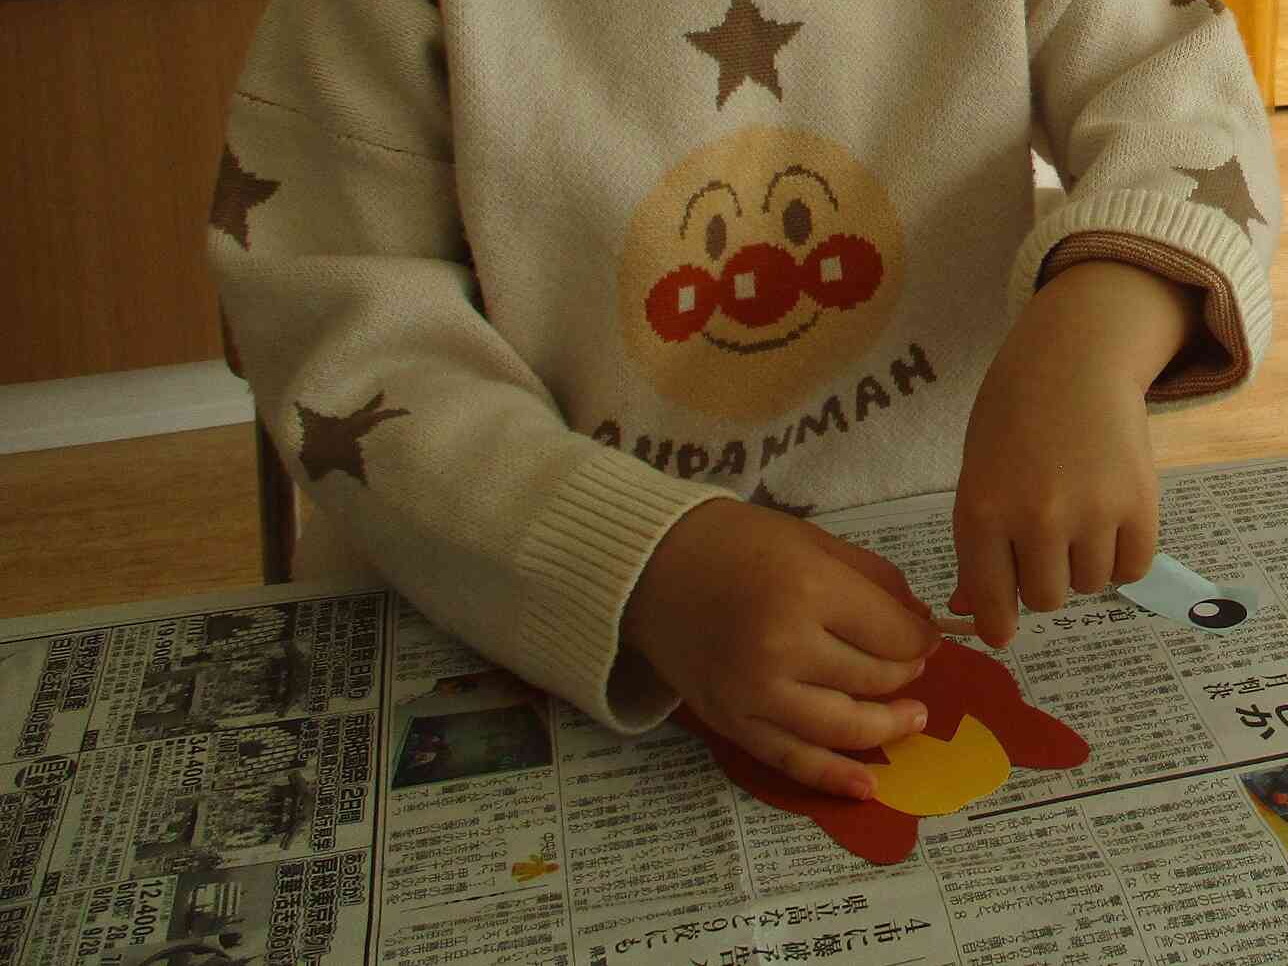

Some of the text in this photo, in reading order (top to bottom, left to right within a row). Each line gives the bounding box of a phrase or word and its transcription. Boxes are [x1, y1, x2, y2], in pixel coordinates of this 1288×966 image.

[615, 894, 870, 954] 県立高など9校にも
[719, 917, 932, 966] 4市に爆破予告
